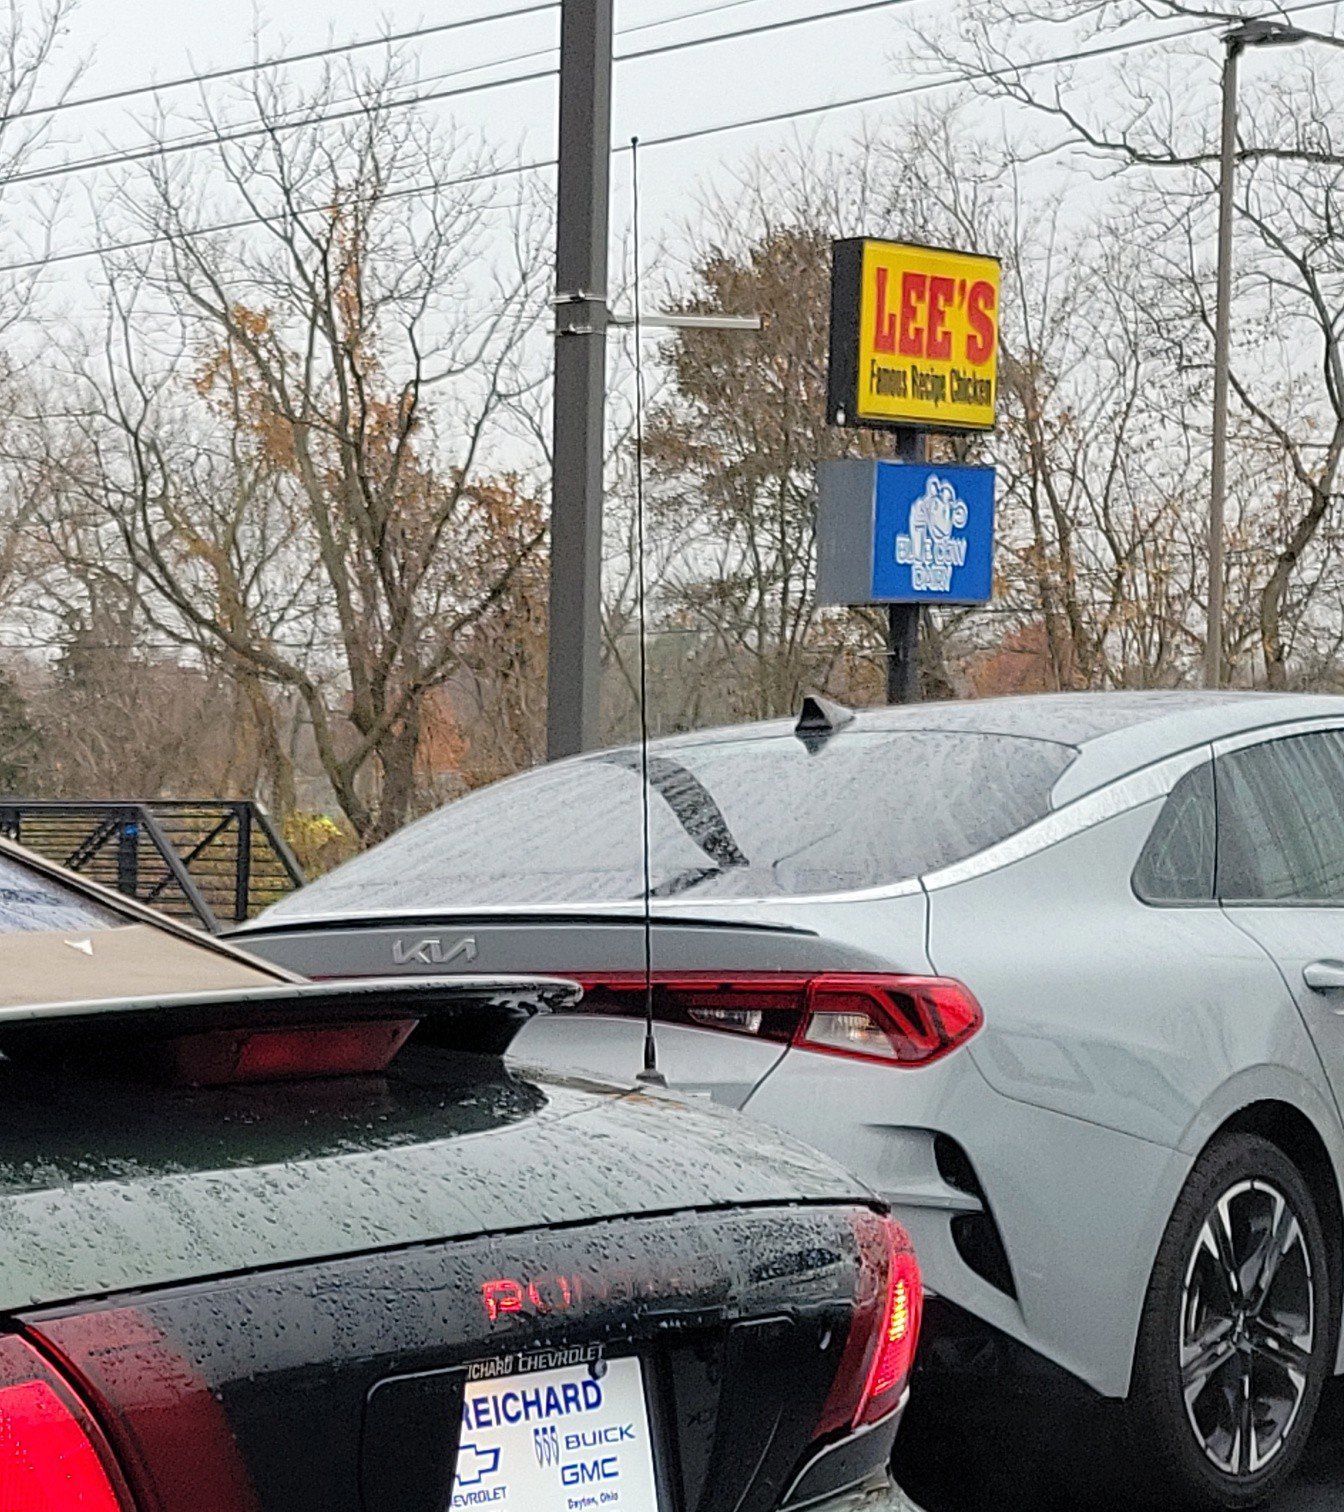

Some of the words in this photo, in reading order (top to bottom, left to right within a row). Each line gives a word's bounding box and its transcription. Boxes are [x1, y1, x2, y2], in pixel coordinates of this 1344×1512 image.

[873, 266, 996, 366] LEE'S
[870, 358, 907, 399] Famous
[911, 364, 946, 408] Recipe
[950, 368, 992, 407] Chicken
[467, 1354, 514, 1381] ICHARD
[518, 1344, 604, 1372] CHEVROLET
[565, 1423, 635, 1450] BUICK
[561, 1456, 619, 1486] GMC
[452, 1486, 506, 1507] EVROLET
